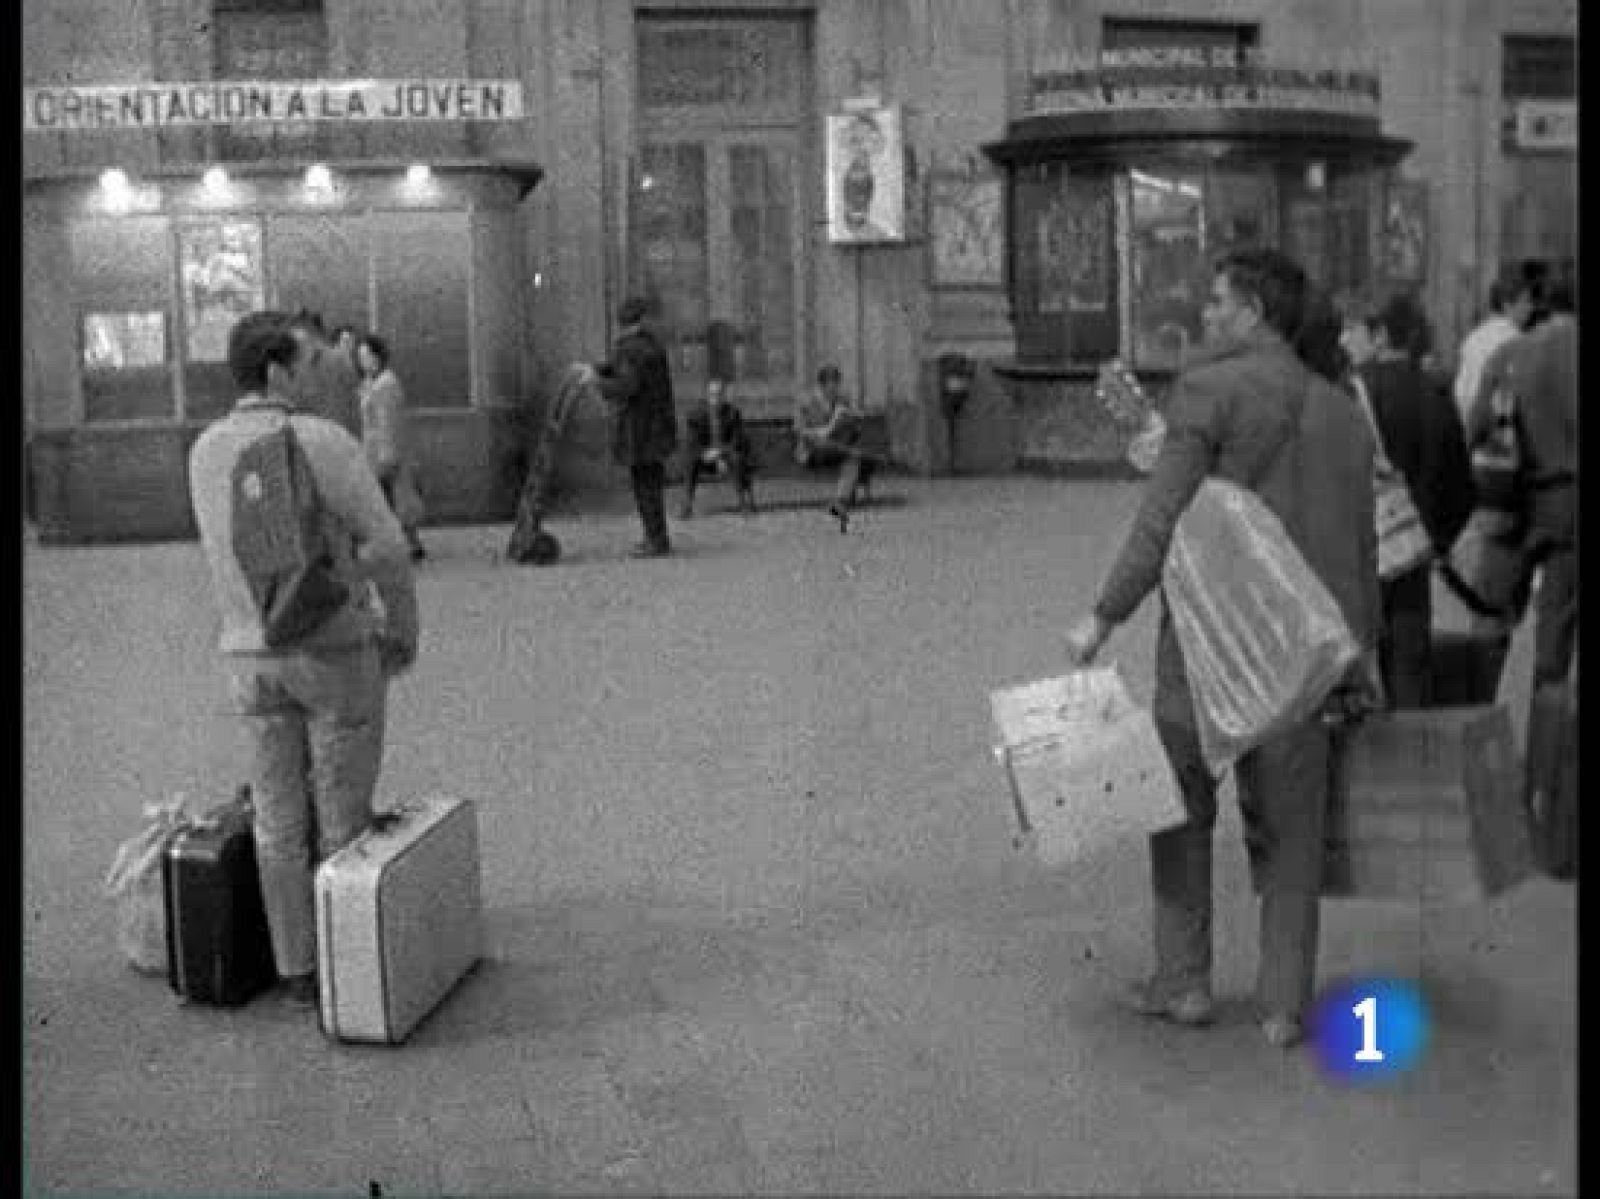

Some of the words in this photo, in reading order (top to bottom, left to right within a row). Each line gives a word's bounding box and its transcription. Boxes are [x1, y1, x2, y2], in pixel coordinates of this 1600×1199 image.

[287, 89, 306, 117] A
[320, 86, 366, 117] LA
[380, 84, 504, 117] JOVEN
